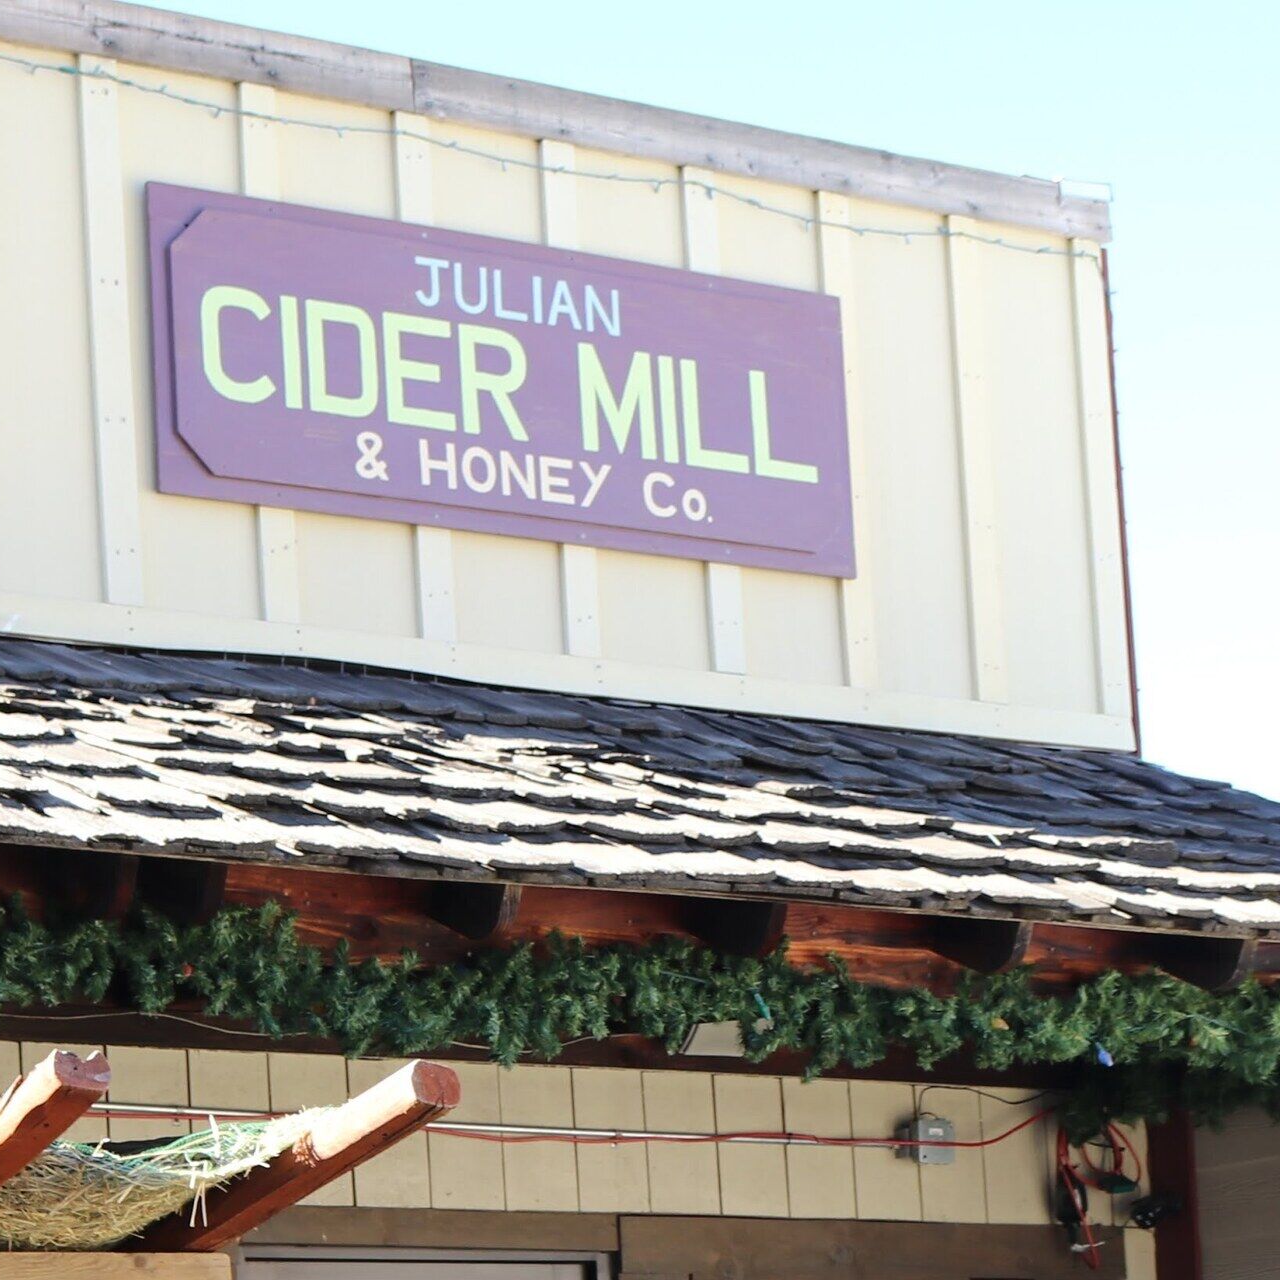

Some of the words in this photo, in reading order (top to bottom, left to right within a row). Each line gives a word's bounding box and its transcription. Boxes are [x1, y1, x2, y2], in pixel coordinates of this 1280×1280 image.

[415, 255, 620, 337] JULIAN
[200, 285, 530, 442] CIDER
[577, 342, 819, 484] MILL
[355, 431, 390, 482] &
[418, 438, 611, 508] HONEY
[643, 471, 713, 524] Co.
